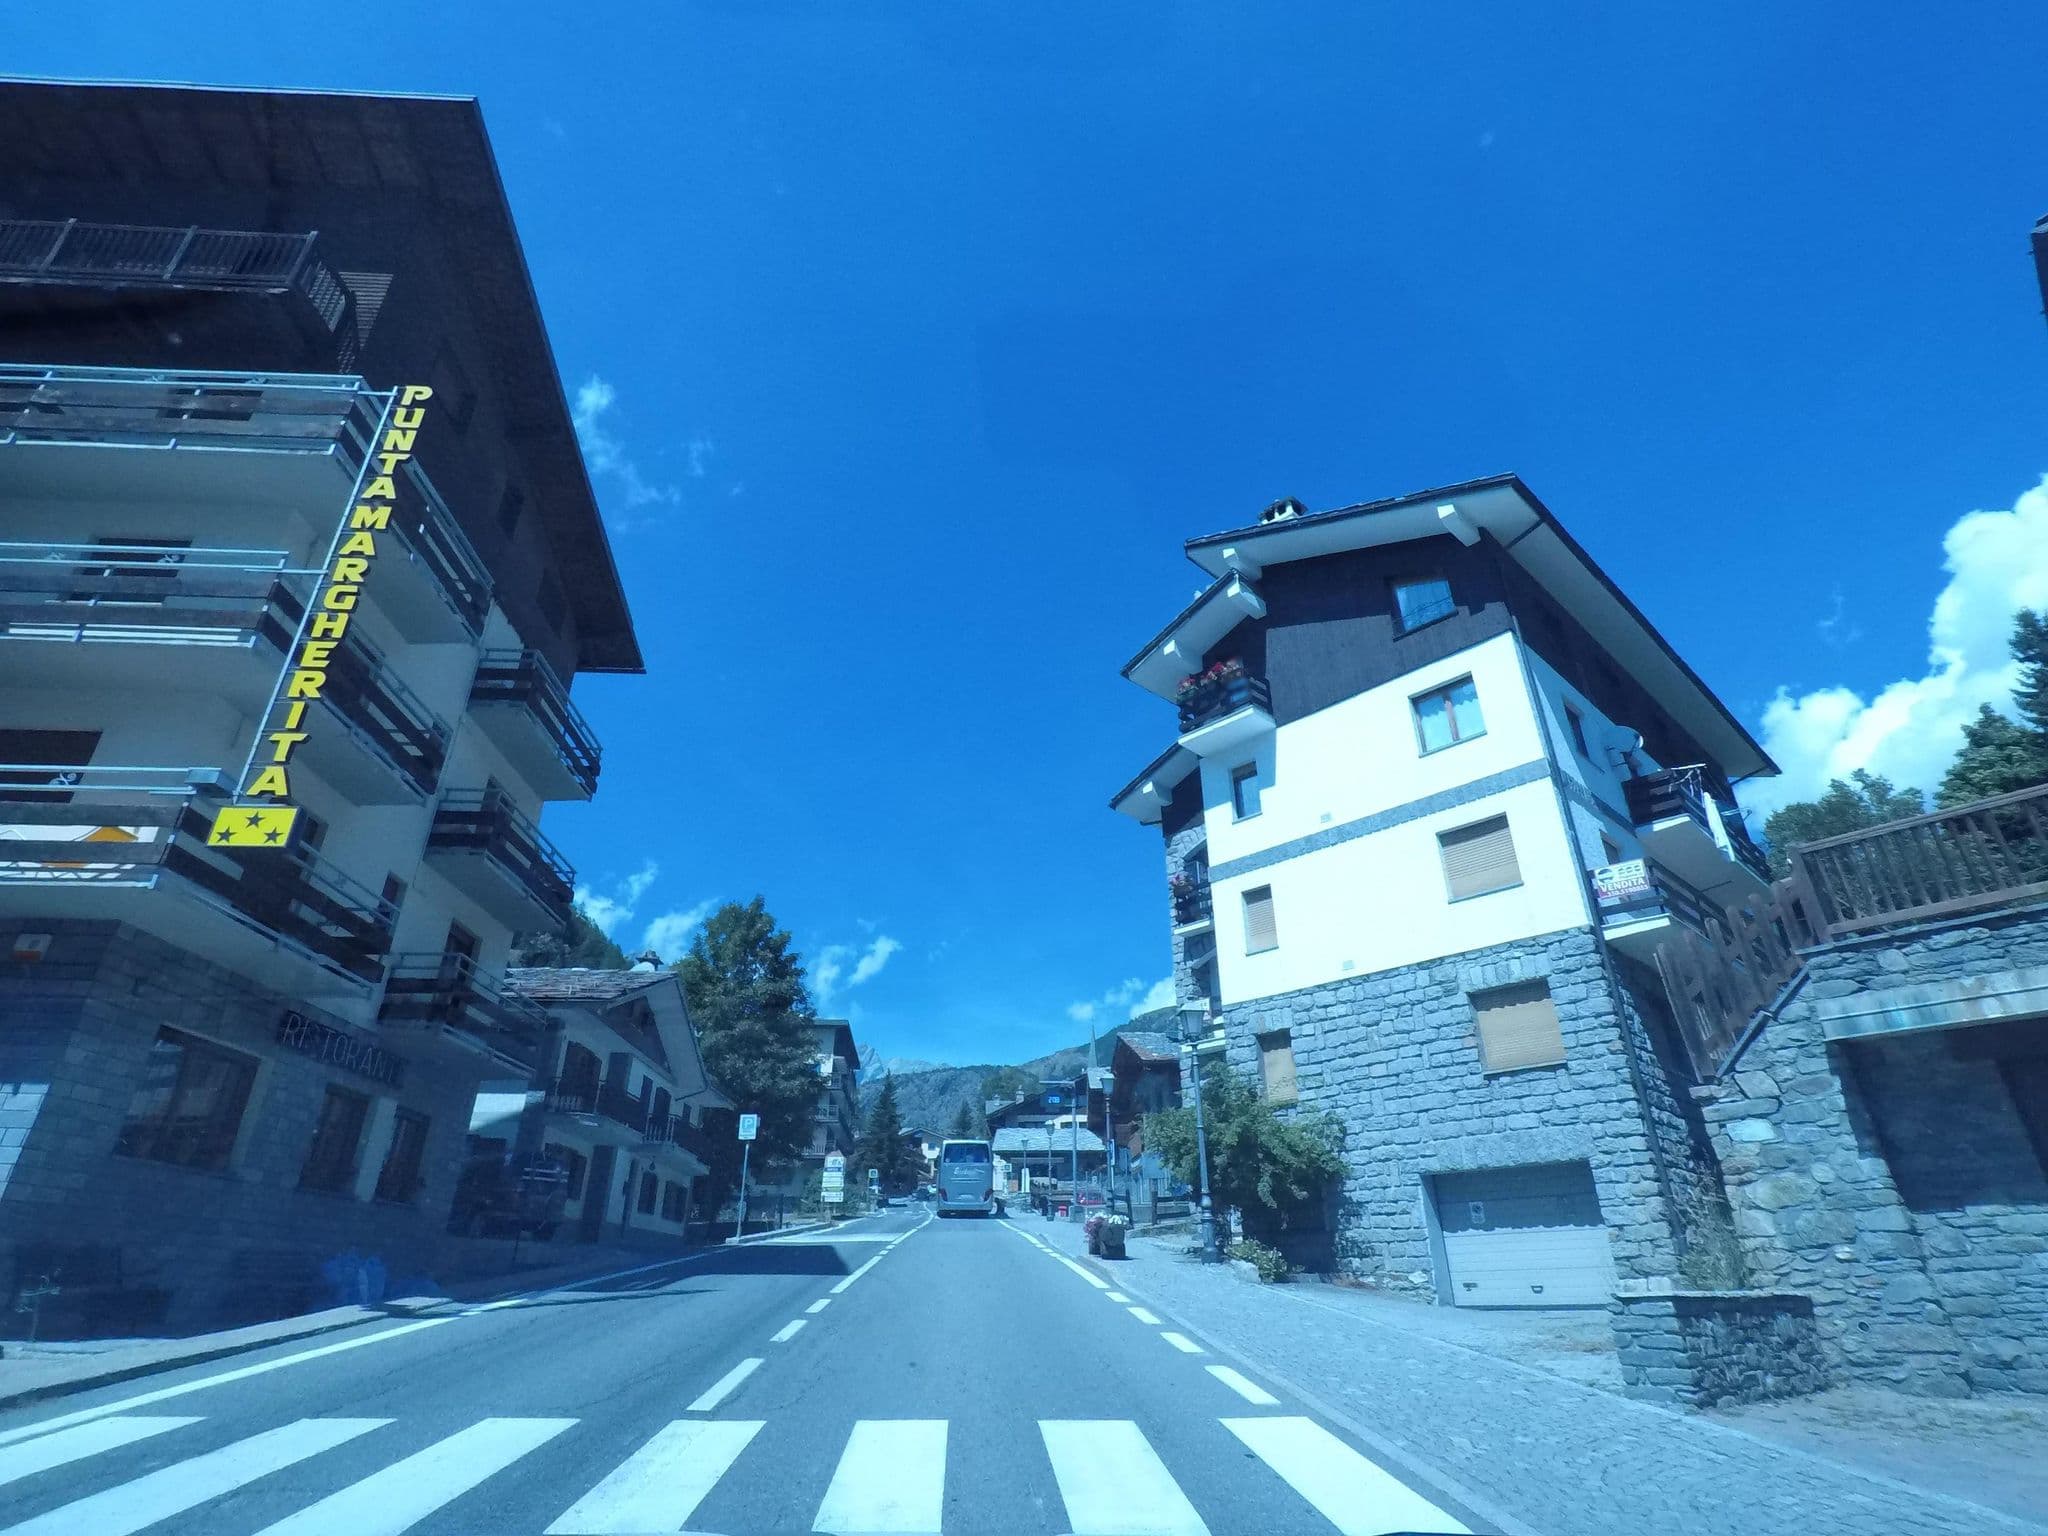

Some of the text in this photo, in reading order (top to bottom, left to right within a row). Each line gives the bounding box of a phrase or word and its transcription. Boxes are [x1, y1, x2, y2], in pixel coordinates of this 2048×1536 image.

[245, 384, 434, 798] PUNTA MARGHERITA
[1599, 877, 1645, 892] VENDITA
[282, 1012, 406, 1084] RITORANT
